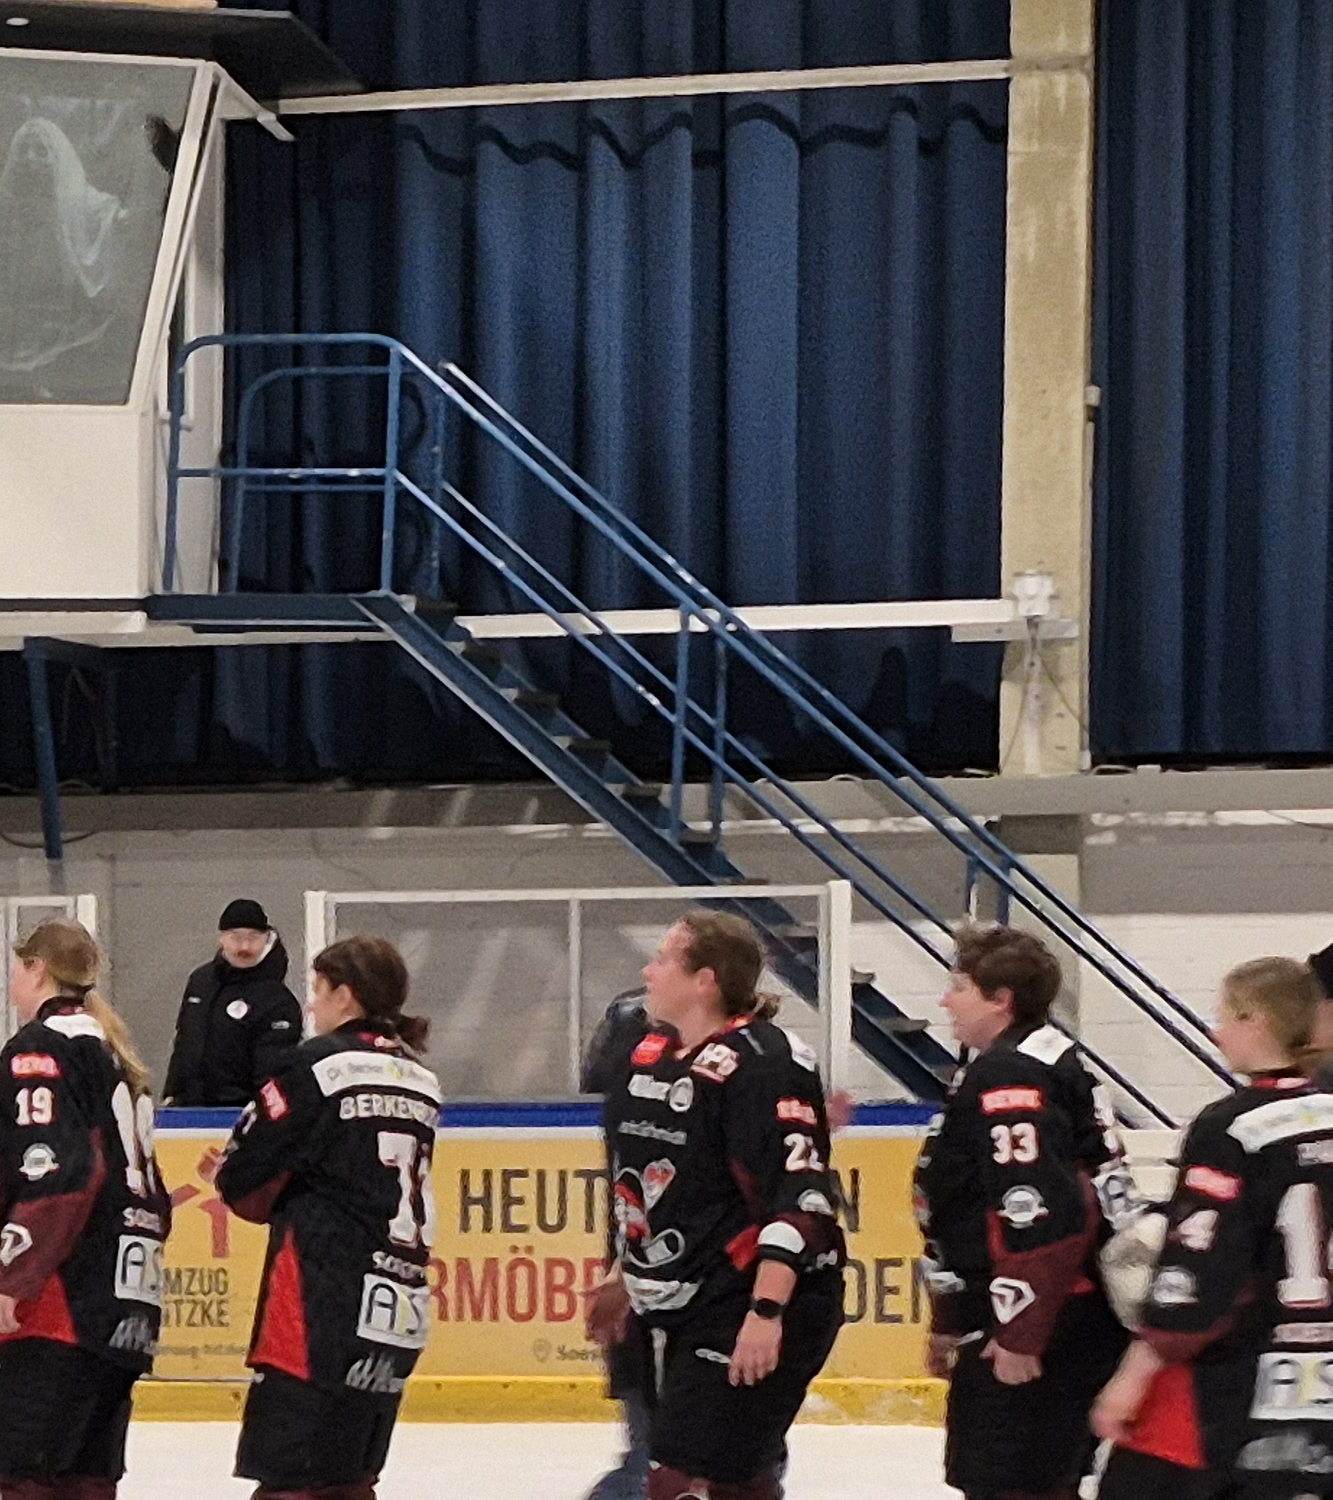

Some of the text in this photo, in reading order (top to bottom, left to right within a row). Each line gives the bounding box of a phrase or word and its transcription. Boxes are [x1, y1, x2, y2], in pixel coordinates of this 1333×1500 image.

[15, 1086, 55, 1125] 19
[990, 1122, 1040, 1164] 33
[1275, 1183, 1333, 1309] 1
